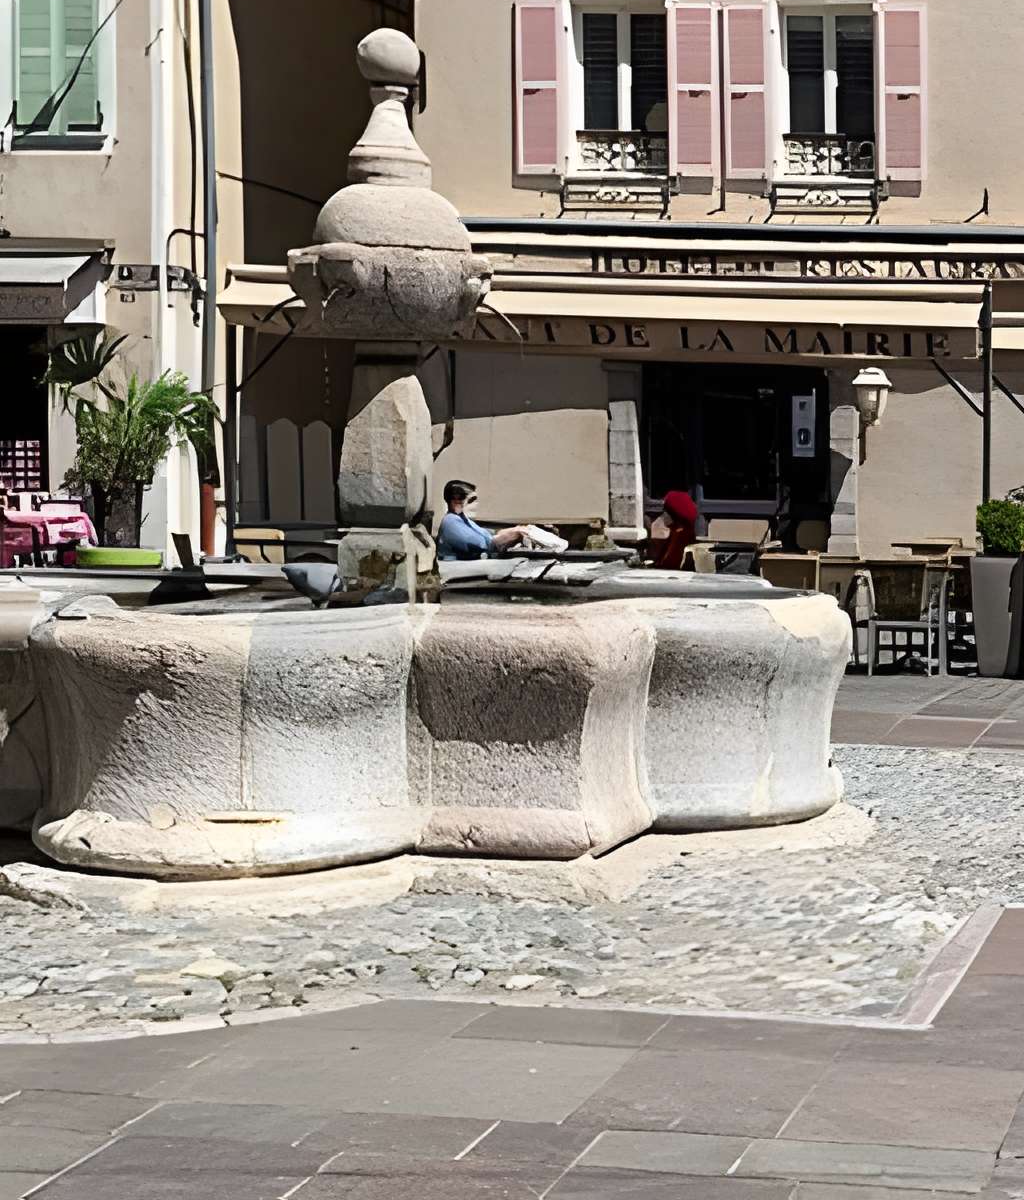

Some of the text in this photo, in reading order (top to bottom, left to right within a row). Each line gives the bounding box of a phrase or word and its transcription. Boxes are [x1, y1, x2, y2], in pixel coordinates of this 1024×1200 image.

[589, 323, 650, 348] DE
[680, 326, 734, 352] LA
[765, 327, 951, 357] MAIRIE
